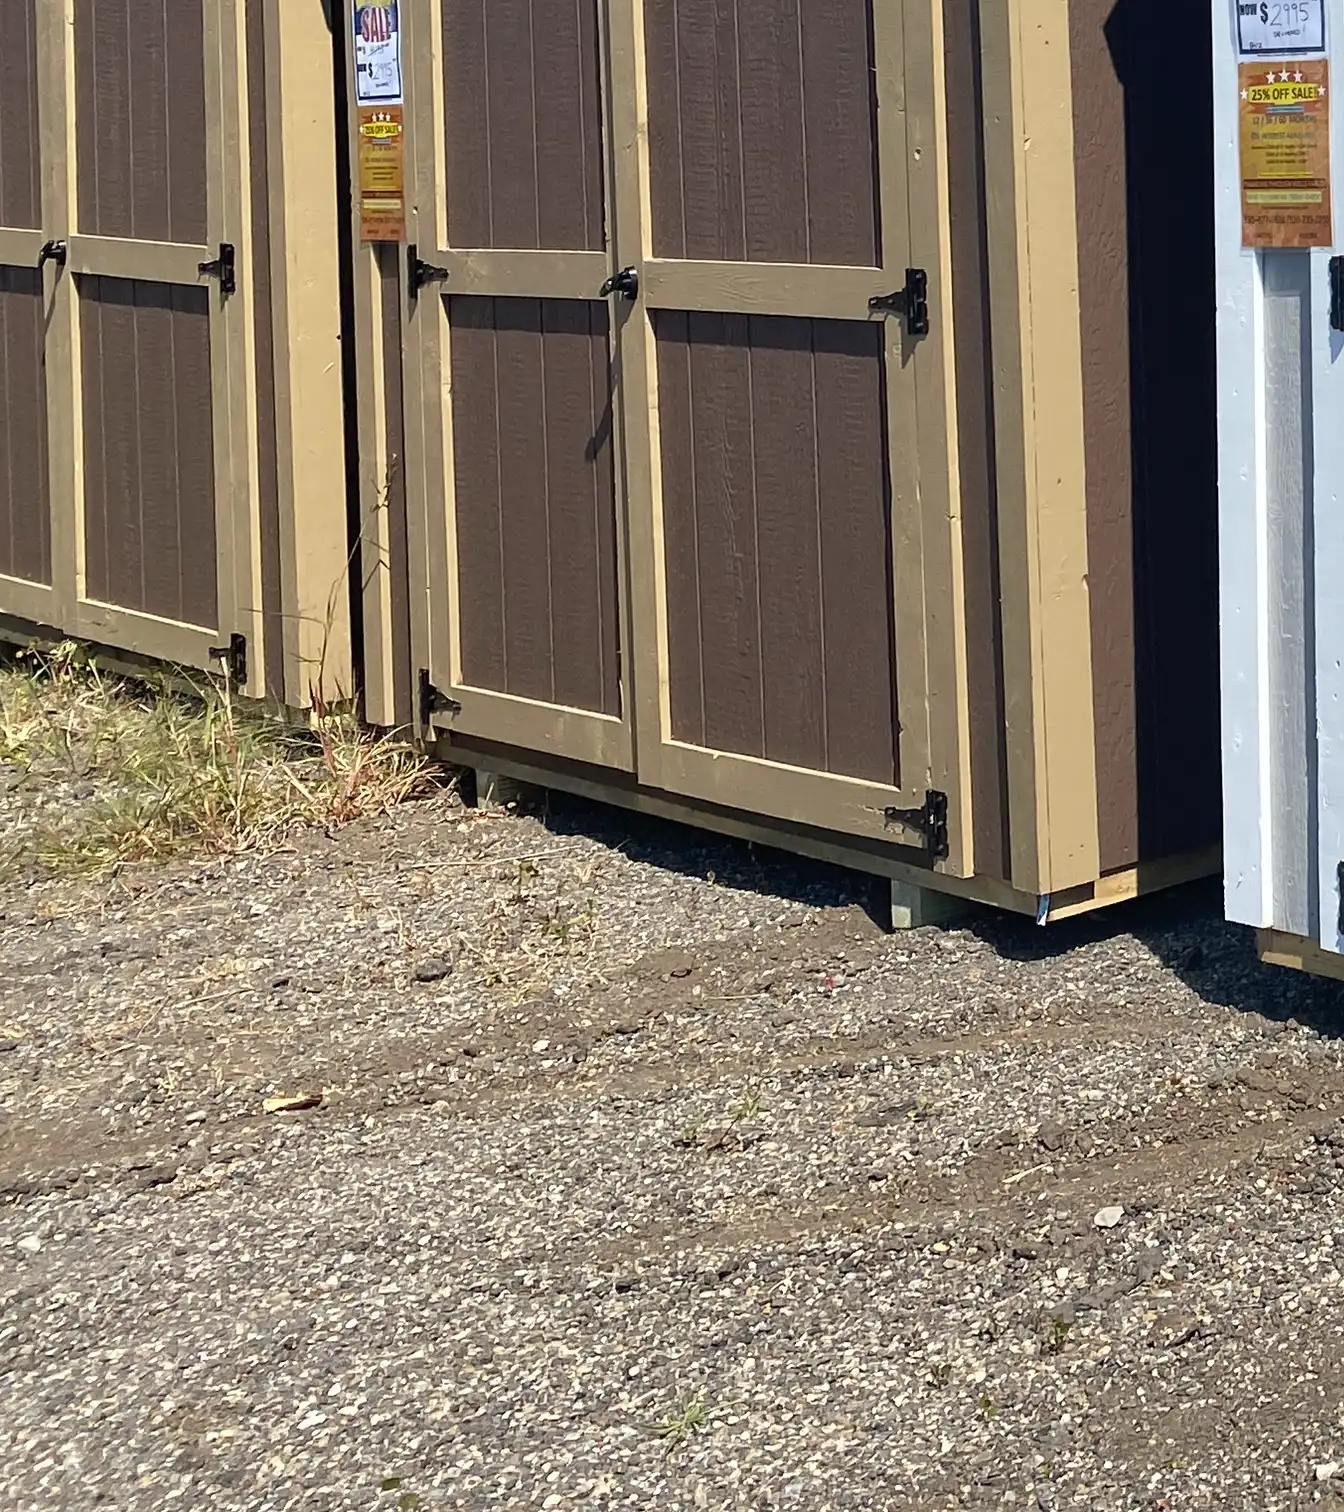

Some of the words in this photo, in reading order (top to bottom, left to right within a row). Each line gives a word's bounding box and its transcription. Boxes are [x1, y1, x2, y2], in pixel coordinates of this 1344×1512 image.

[361, 7, 391, 43] SALE
[1251, 88, 1271, 101] 25%
[1272, 88, 1290, 100] OFF
